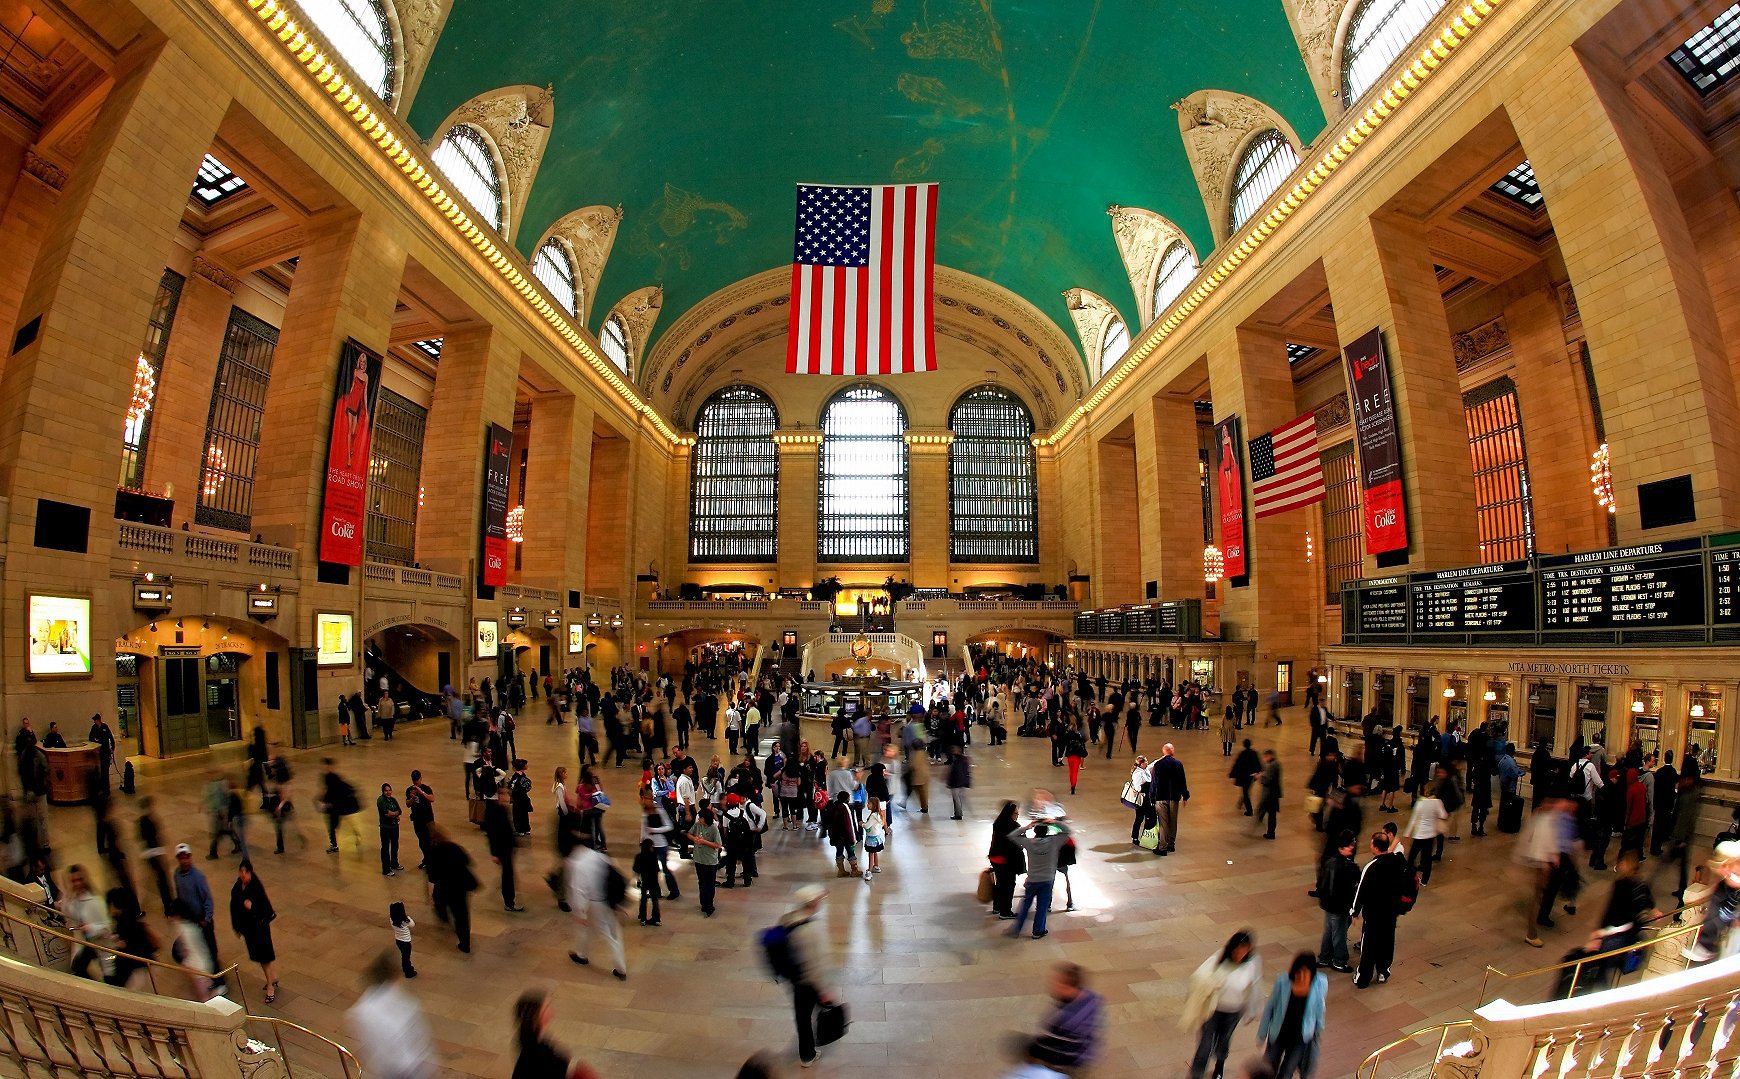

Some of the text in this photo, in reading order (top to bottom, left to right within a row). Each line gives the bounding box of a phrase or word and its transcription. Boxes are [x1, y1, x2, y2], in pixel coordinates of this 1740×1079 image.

[329, 474, 345, 485] ROAD
[1375, 513, 1396, 529] Coke
[332, 522, 354, 539] Coke
[1575, 544, 1663, 563] HARLEM LINE DEPARTURES
[1714, 553, 1729, 561] TIME
[1437, 565, 1504, 579] HARLEM LINE DEPARTURES
[1571, 568, 1604, 577] DESTINATION
[1610, 564, 1635, 573] REMARKS
[1369, 578, 1398, 586] INFORMATION
[1508, 662, 1630, 675] MTA METRO-NORTH TICKETS
